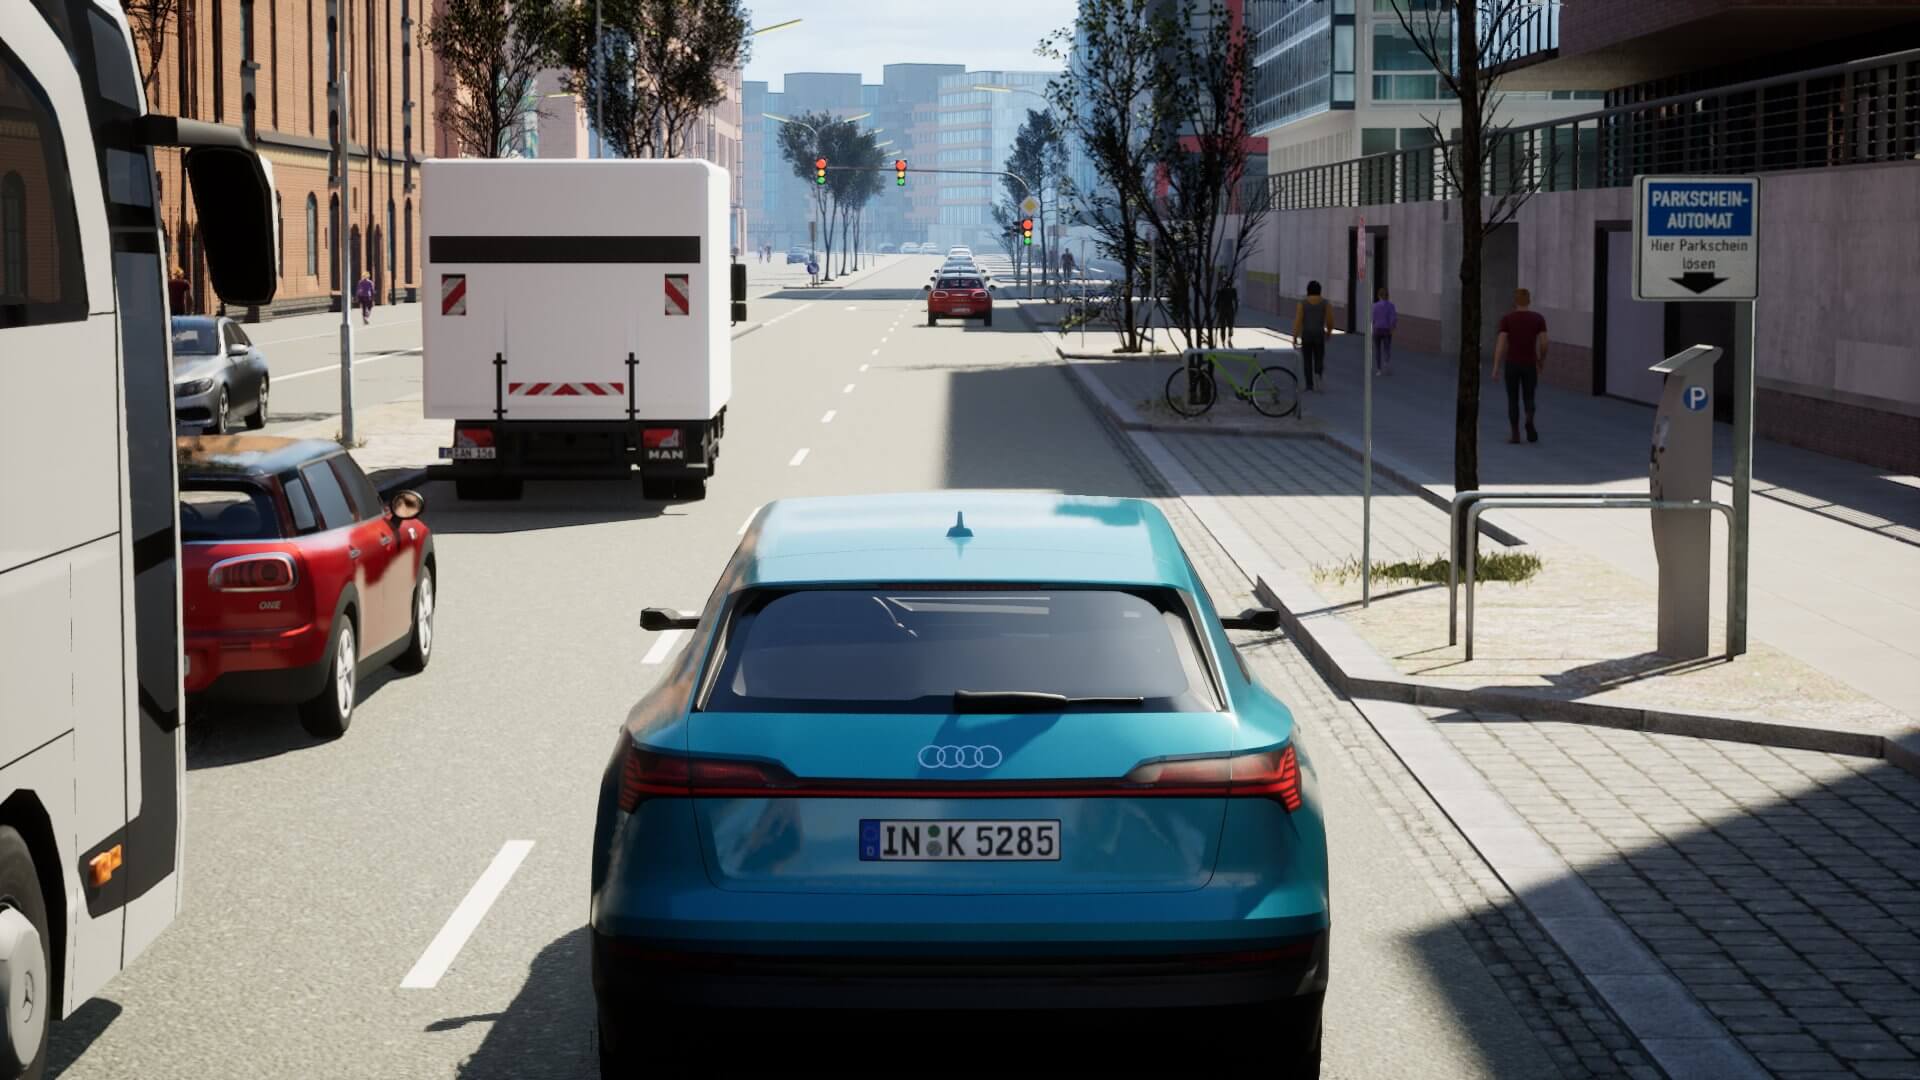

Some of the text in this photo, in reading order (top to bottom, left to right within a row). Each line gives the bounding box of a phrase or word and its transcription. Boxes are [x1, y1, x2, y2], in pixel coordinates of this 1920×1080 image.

[1652, 190, 1749, 207] PARKSCHEIN-
[1667, 212, 1734, 229] AUTOMAT
[1651, 239, 1748, 251] Hier Parkschein
[1682, 257, 1716, 270] lösen
[1690, 386, 1706, 409] P
[648, 449, 684, 460] MAN
[259, 600, 281, 610] ONE
[883, 826, 1054, 856] IN K 5285
